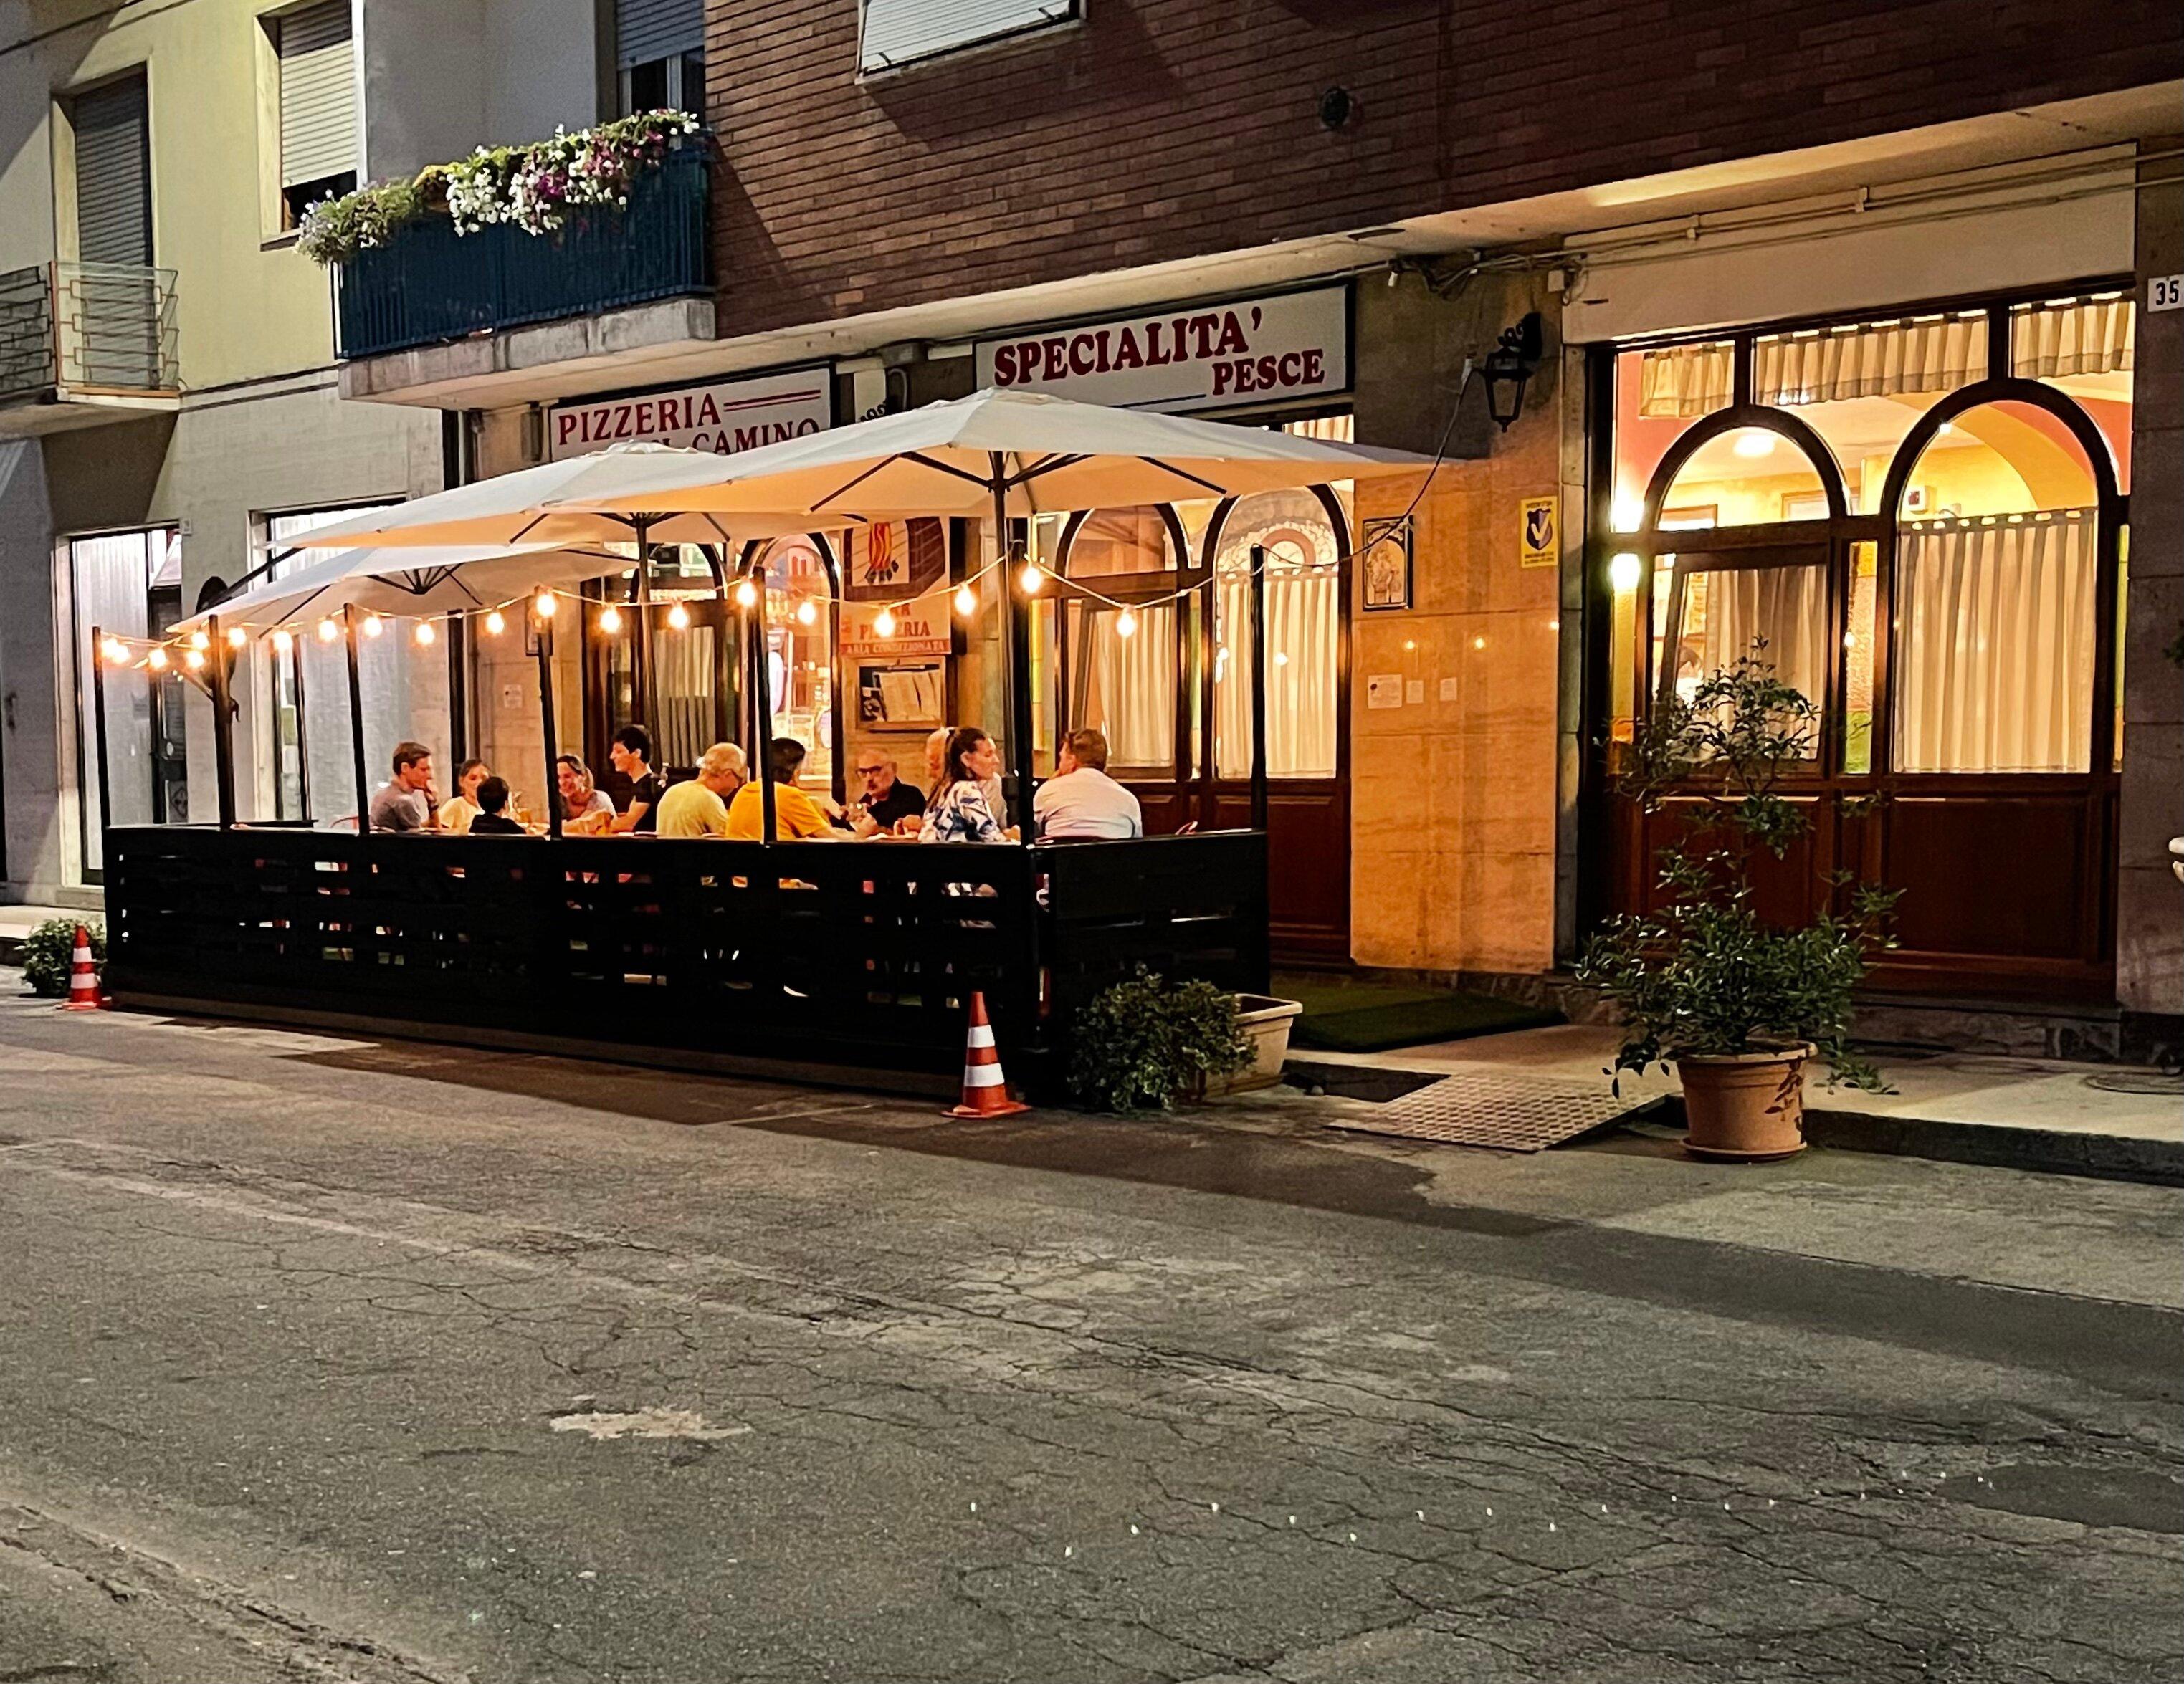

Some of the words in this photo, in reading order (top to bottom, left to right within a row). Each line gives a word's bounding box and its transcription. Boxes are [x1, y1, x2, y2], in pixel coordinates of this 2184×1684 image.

[2155, 279, 2180, 306] 35
[994, 306, 1262, 387] SPECIALITA'
[1212, 348, 1325, 396] PESCE
[559, 393, 721, 446] PIZZERIA
[692, 418, 820, 455] CAMINO
